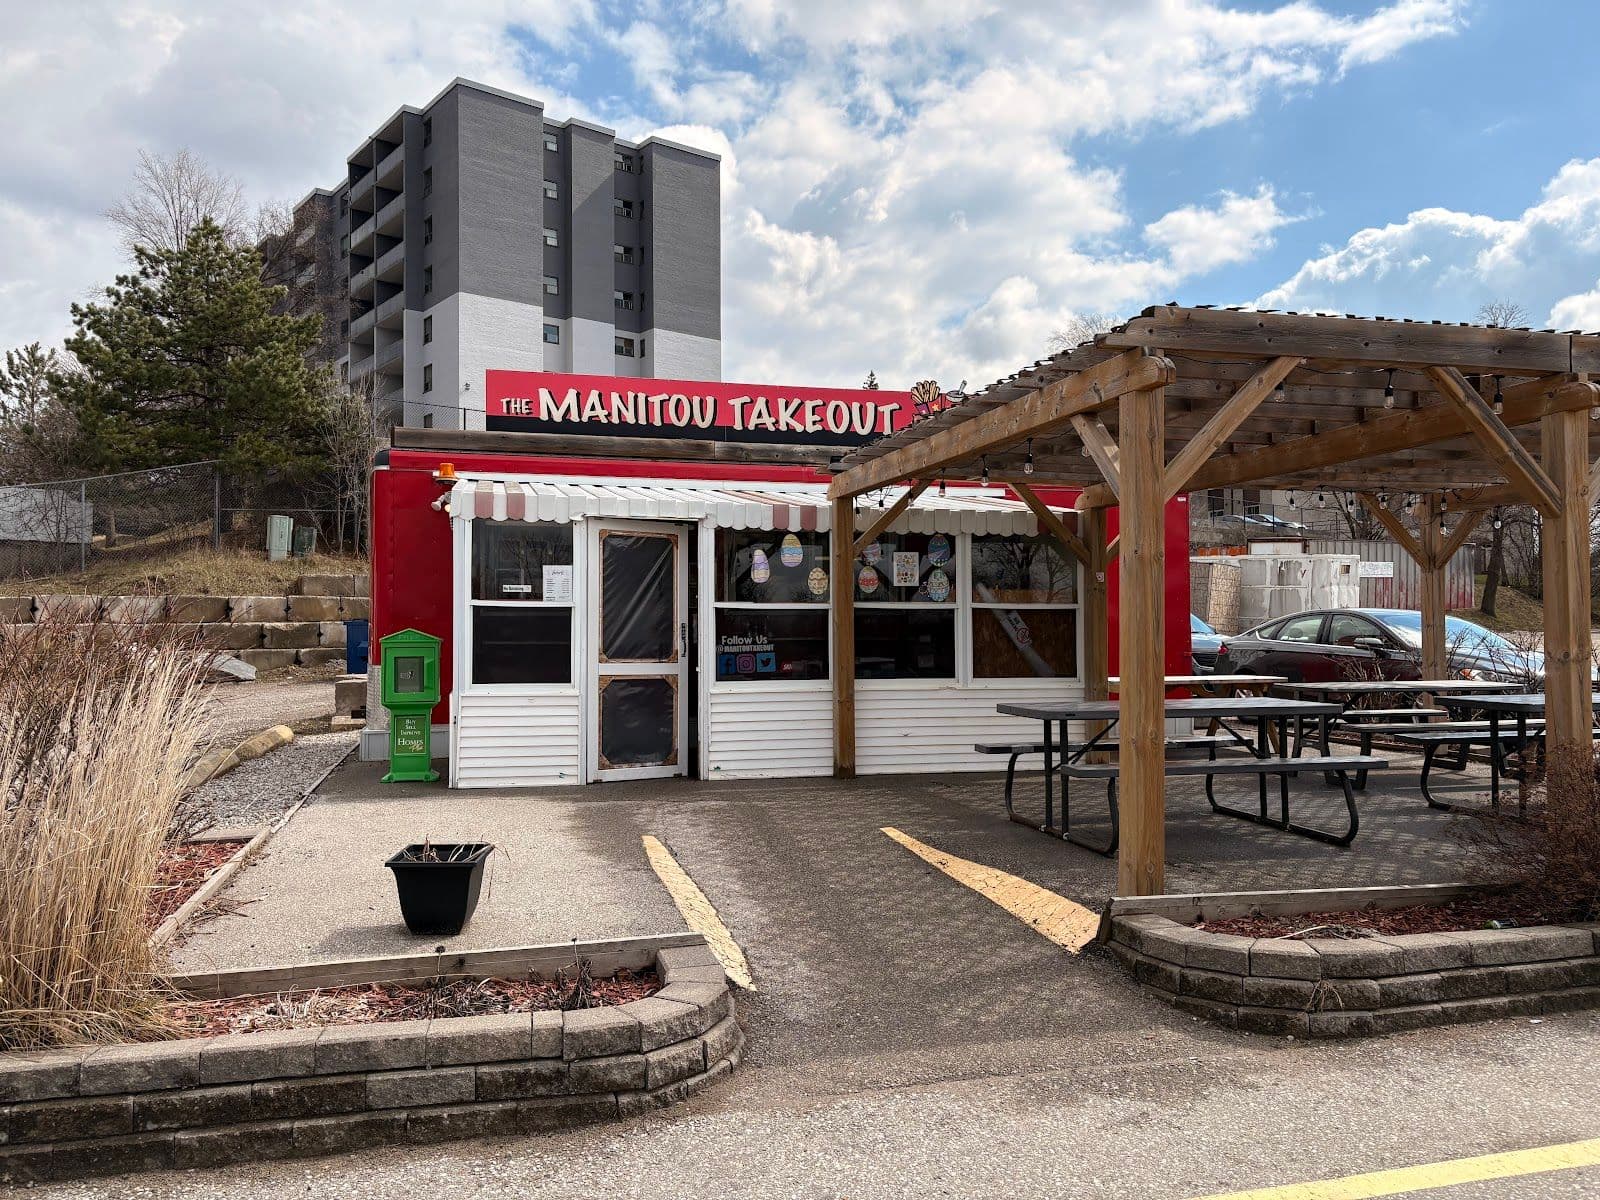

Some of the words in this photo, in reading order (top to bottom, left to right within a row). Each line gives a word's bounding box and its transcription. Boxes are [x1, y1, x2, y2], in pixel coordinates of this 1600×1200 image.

[500, 397, 532, 415] THE
[538, 387, 717, 429] MANITOU
[728, 395, 902, 436] TAKEOUT
[721, 635, 753, 645] Follow
[755, 634, 768, 645] Us
